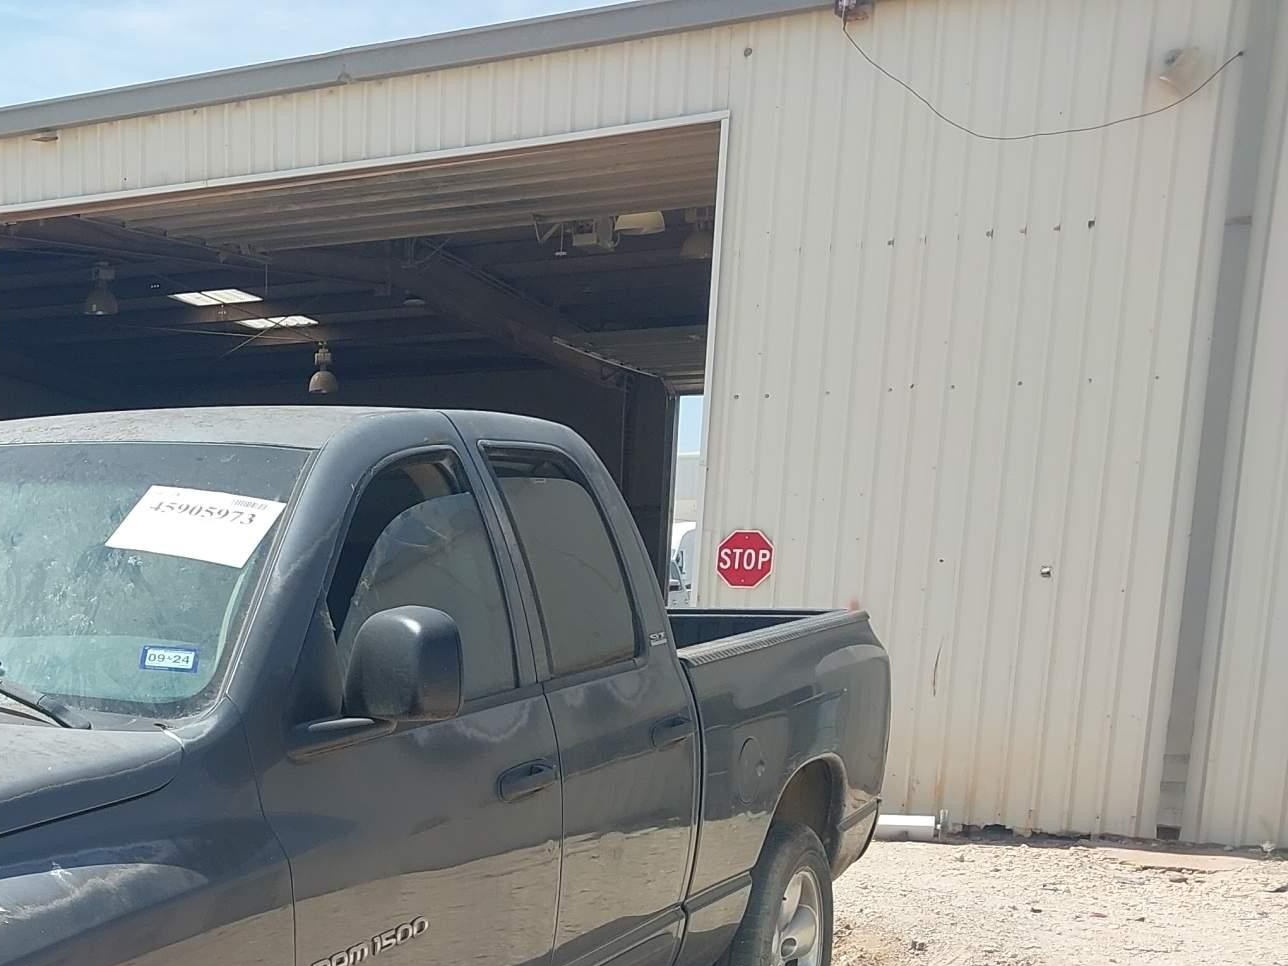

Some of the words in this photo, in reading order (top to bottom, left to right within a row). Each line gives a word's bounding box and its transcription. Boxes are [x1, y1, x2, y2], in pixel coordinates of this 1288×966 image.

[149, 501, 257, 525] 45905973
[719, 548, 771, 570] STOP
[370, 915, 430, 956] 1500
